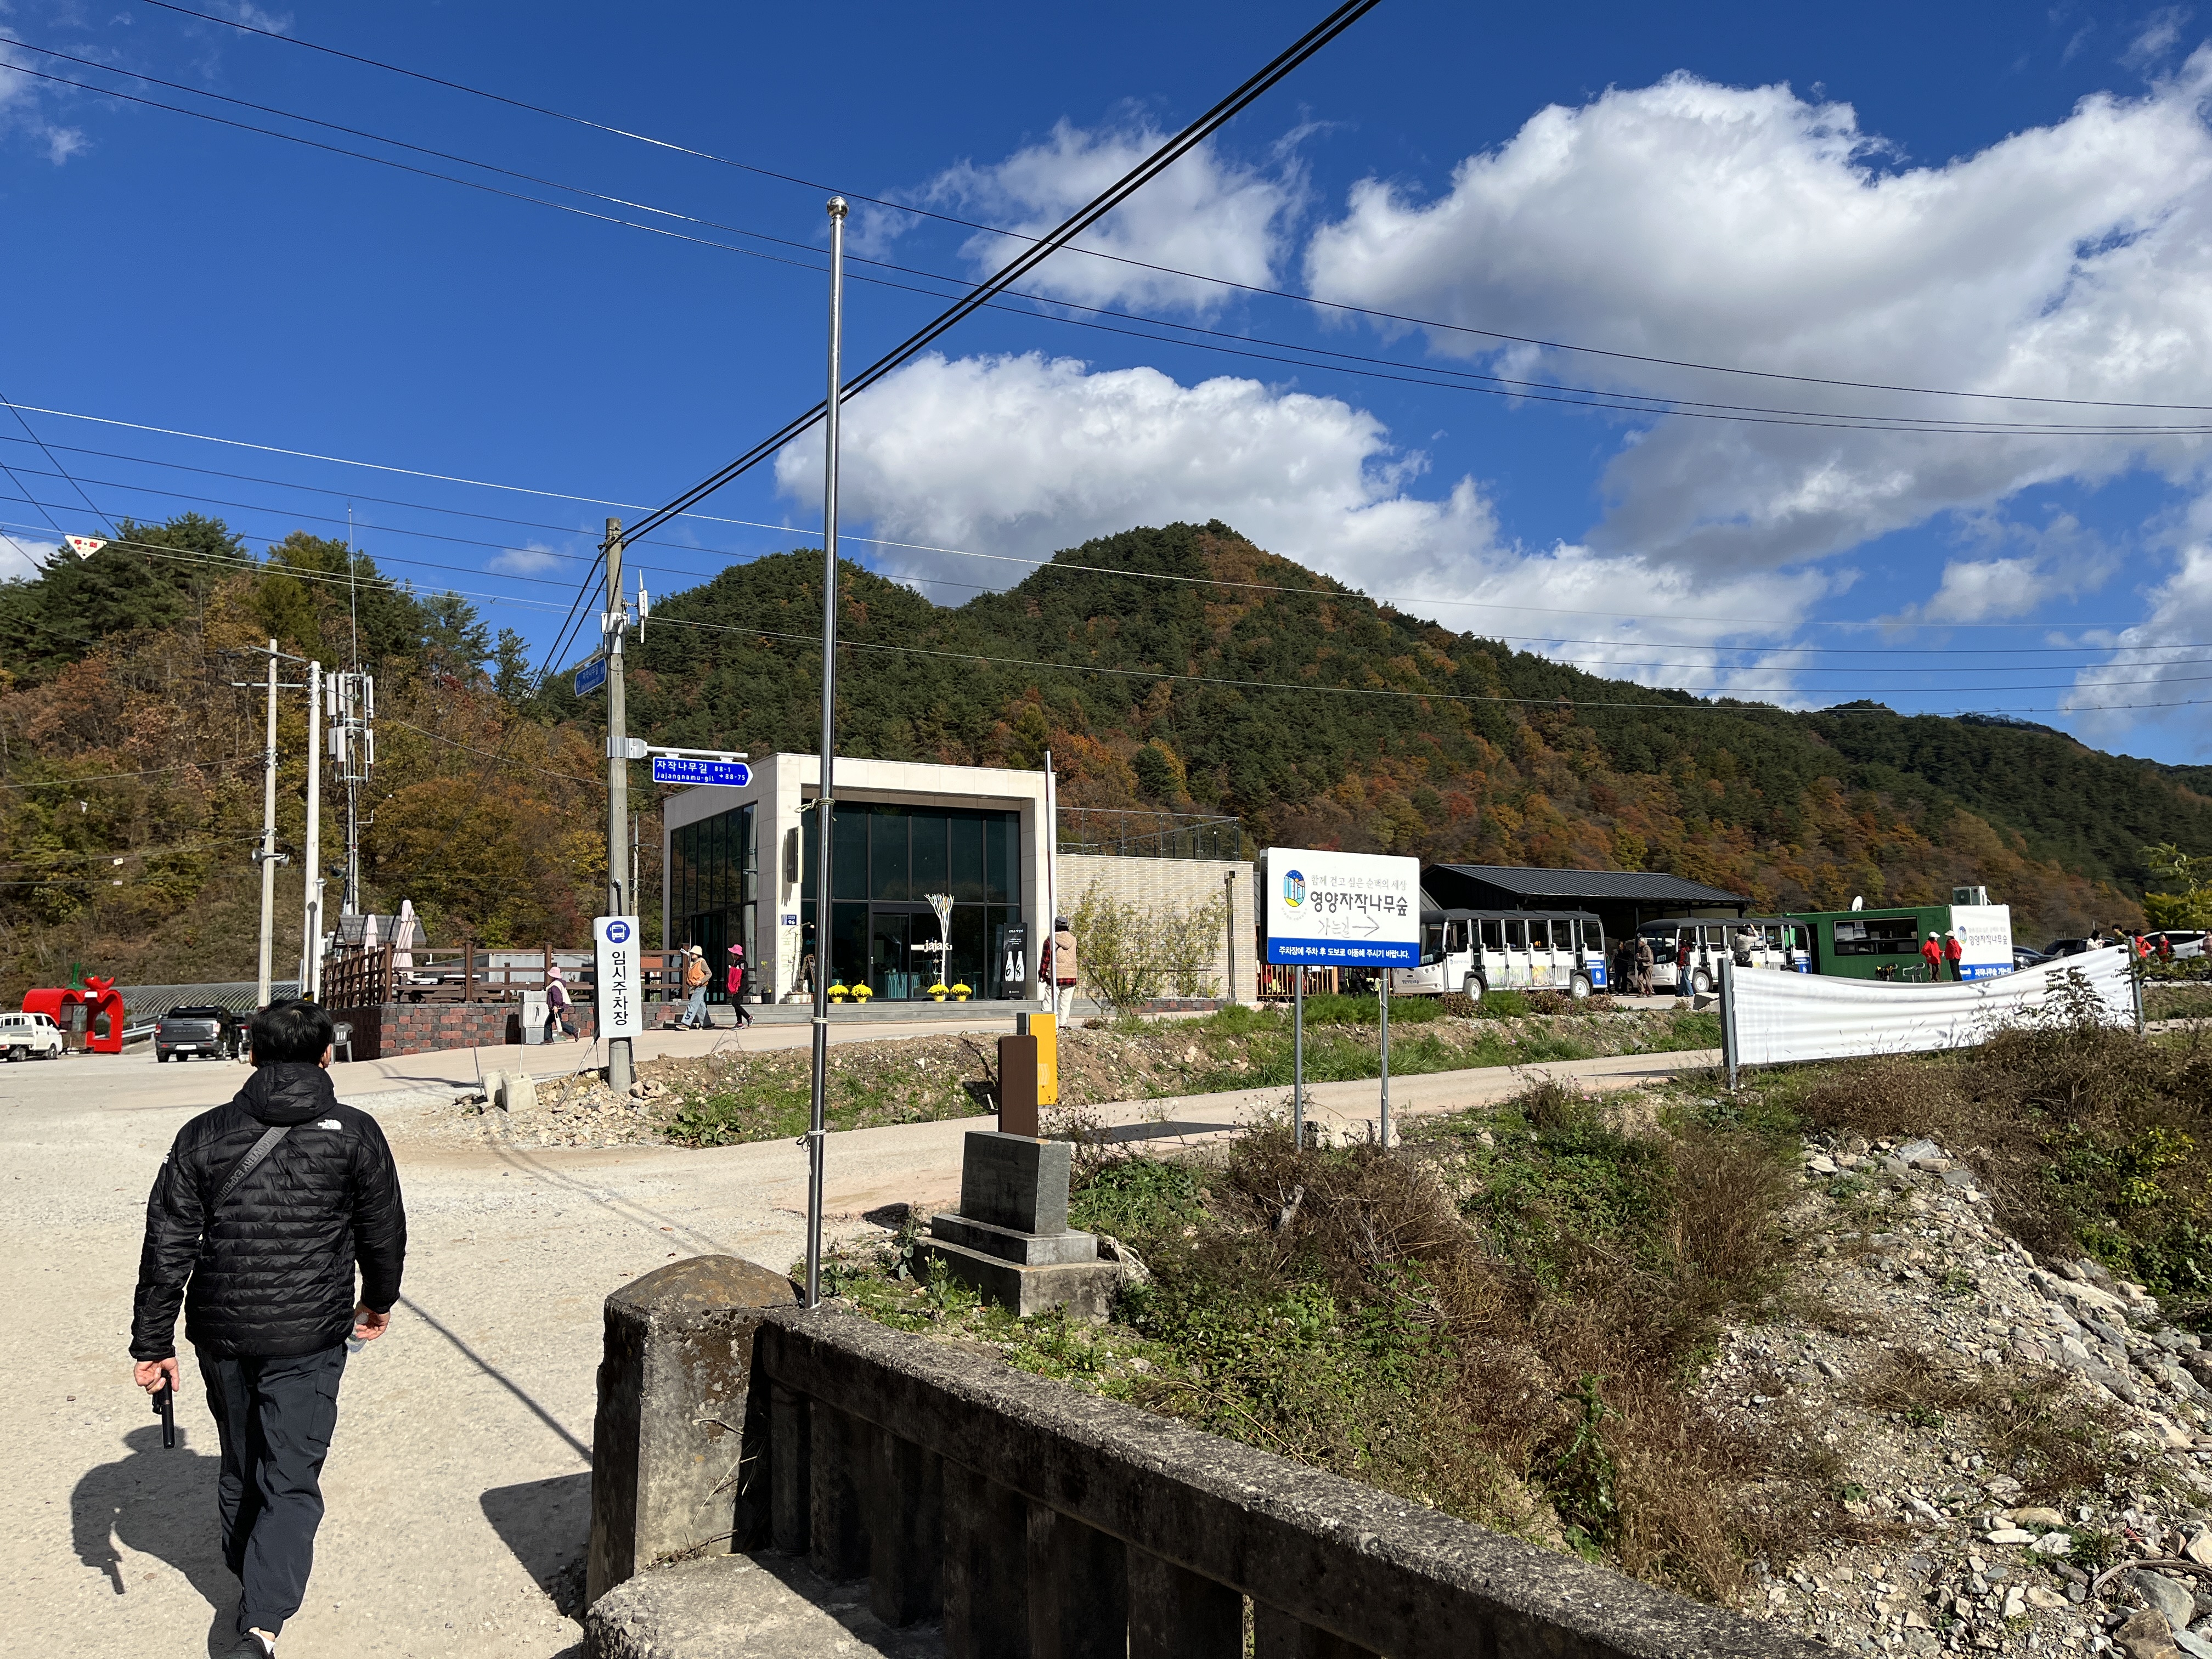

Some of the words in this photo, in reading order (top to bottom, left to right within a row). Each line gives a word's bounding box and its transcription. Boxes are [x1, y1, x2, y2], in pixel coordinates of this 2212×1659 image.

[657, 760, 707, 774] 자작나무길
[657, 772, 714, 782] Jajangnamu-gil
[1311, 874, 1327, 886] 함께
[1330, 876, 1346, 887] 걷고
[1348, 877, 1364, 888] 싶은
[1366, 878, 1389, 890] 순백의
[1391, 879, 1407, 891] 세상
[1310, 891, 1408, 916] 영양자작나무숲
[1318, 916, 1351, 938] 가는길
[924, 939, 950, 952] jajak
[1968, 934, 2007, 946] 영양자작나무숲
[1278, 946, 1304, 956] 주차장에
[1305, 947, 1318, 956] 주차
[1319, 947, 1327, 956] 후
[1327, 948, 1346, 956] 도보로
[1347, 948, 1365, 958] 이동해
[1366, 949, 1384, 958] 주시기
[612, 950, 629, 1026] 임시주차장
